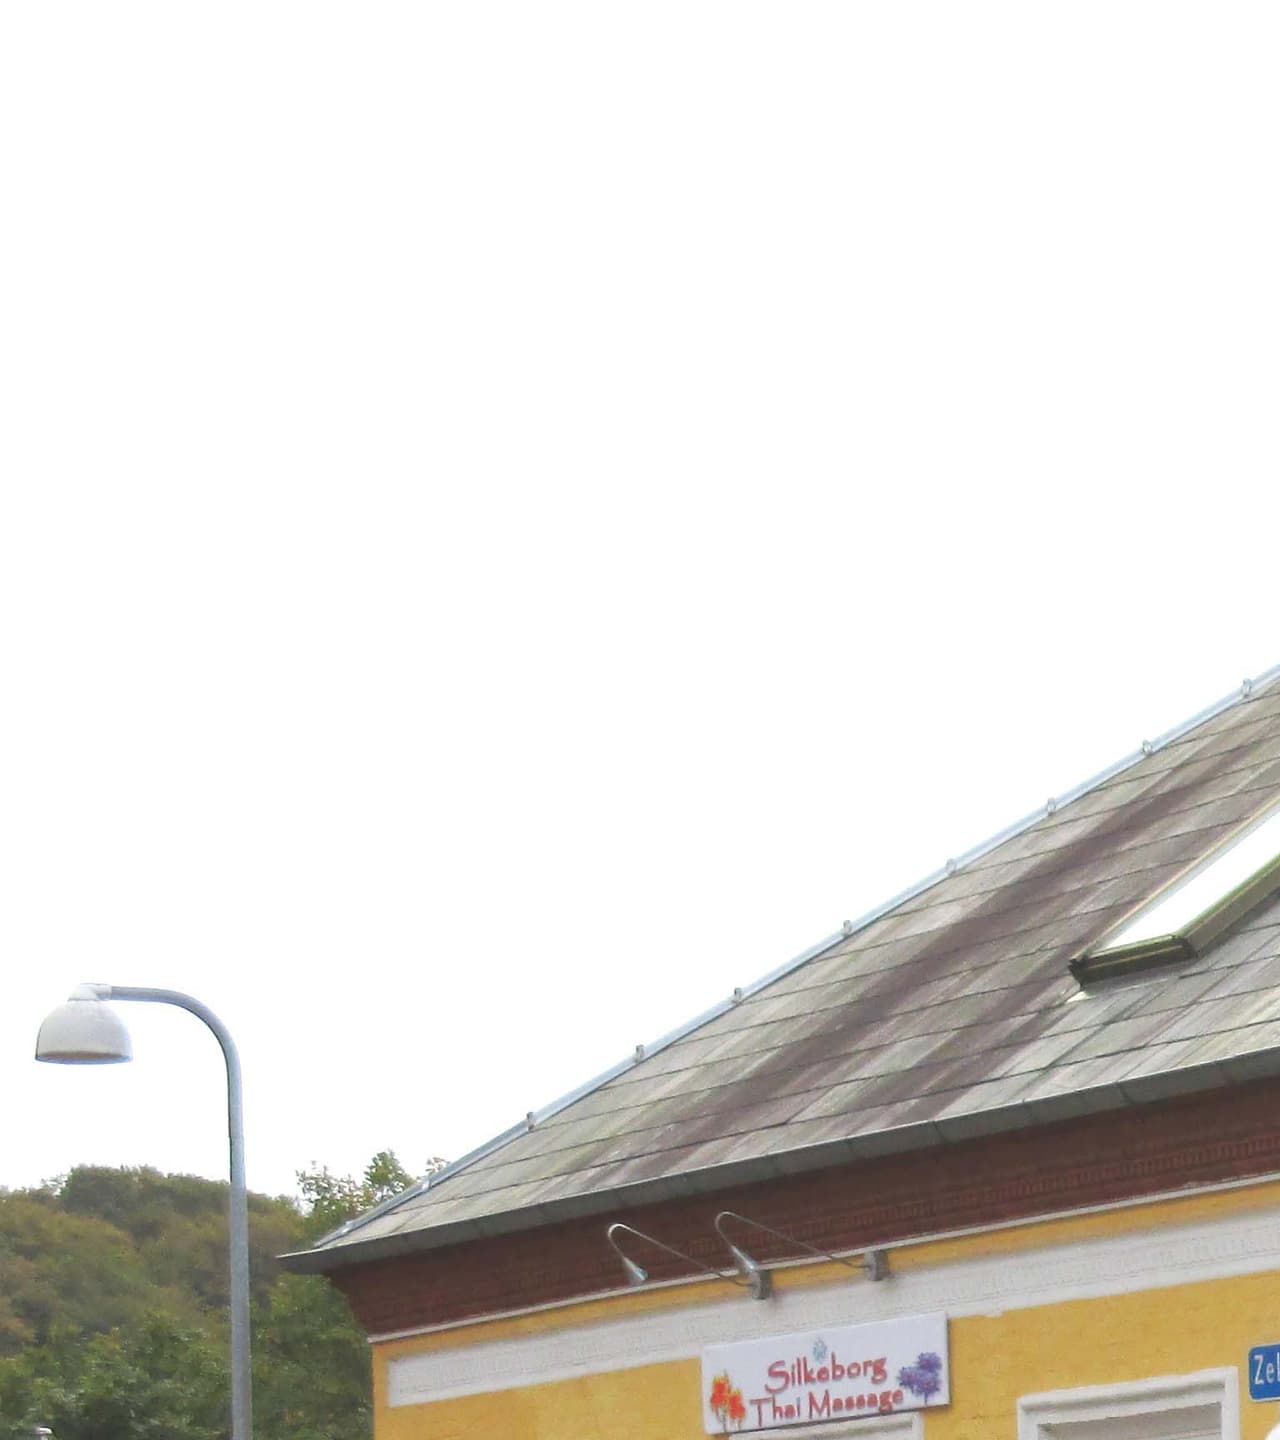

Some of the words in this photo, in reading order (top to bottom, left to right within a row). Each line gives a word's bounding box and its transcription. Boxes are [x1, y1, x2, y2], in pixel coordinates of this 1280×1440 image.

[764, 1351, 888, 1394] Silkeborg
[749, 1393, 801, 1427] Thai
[808, 1388, 904, 1420] Massage
